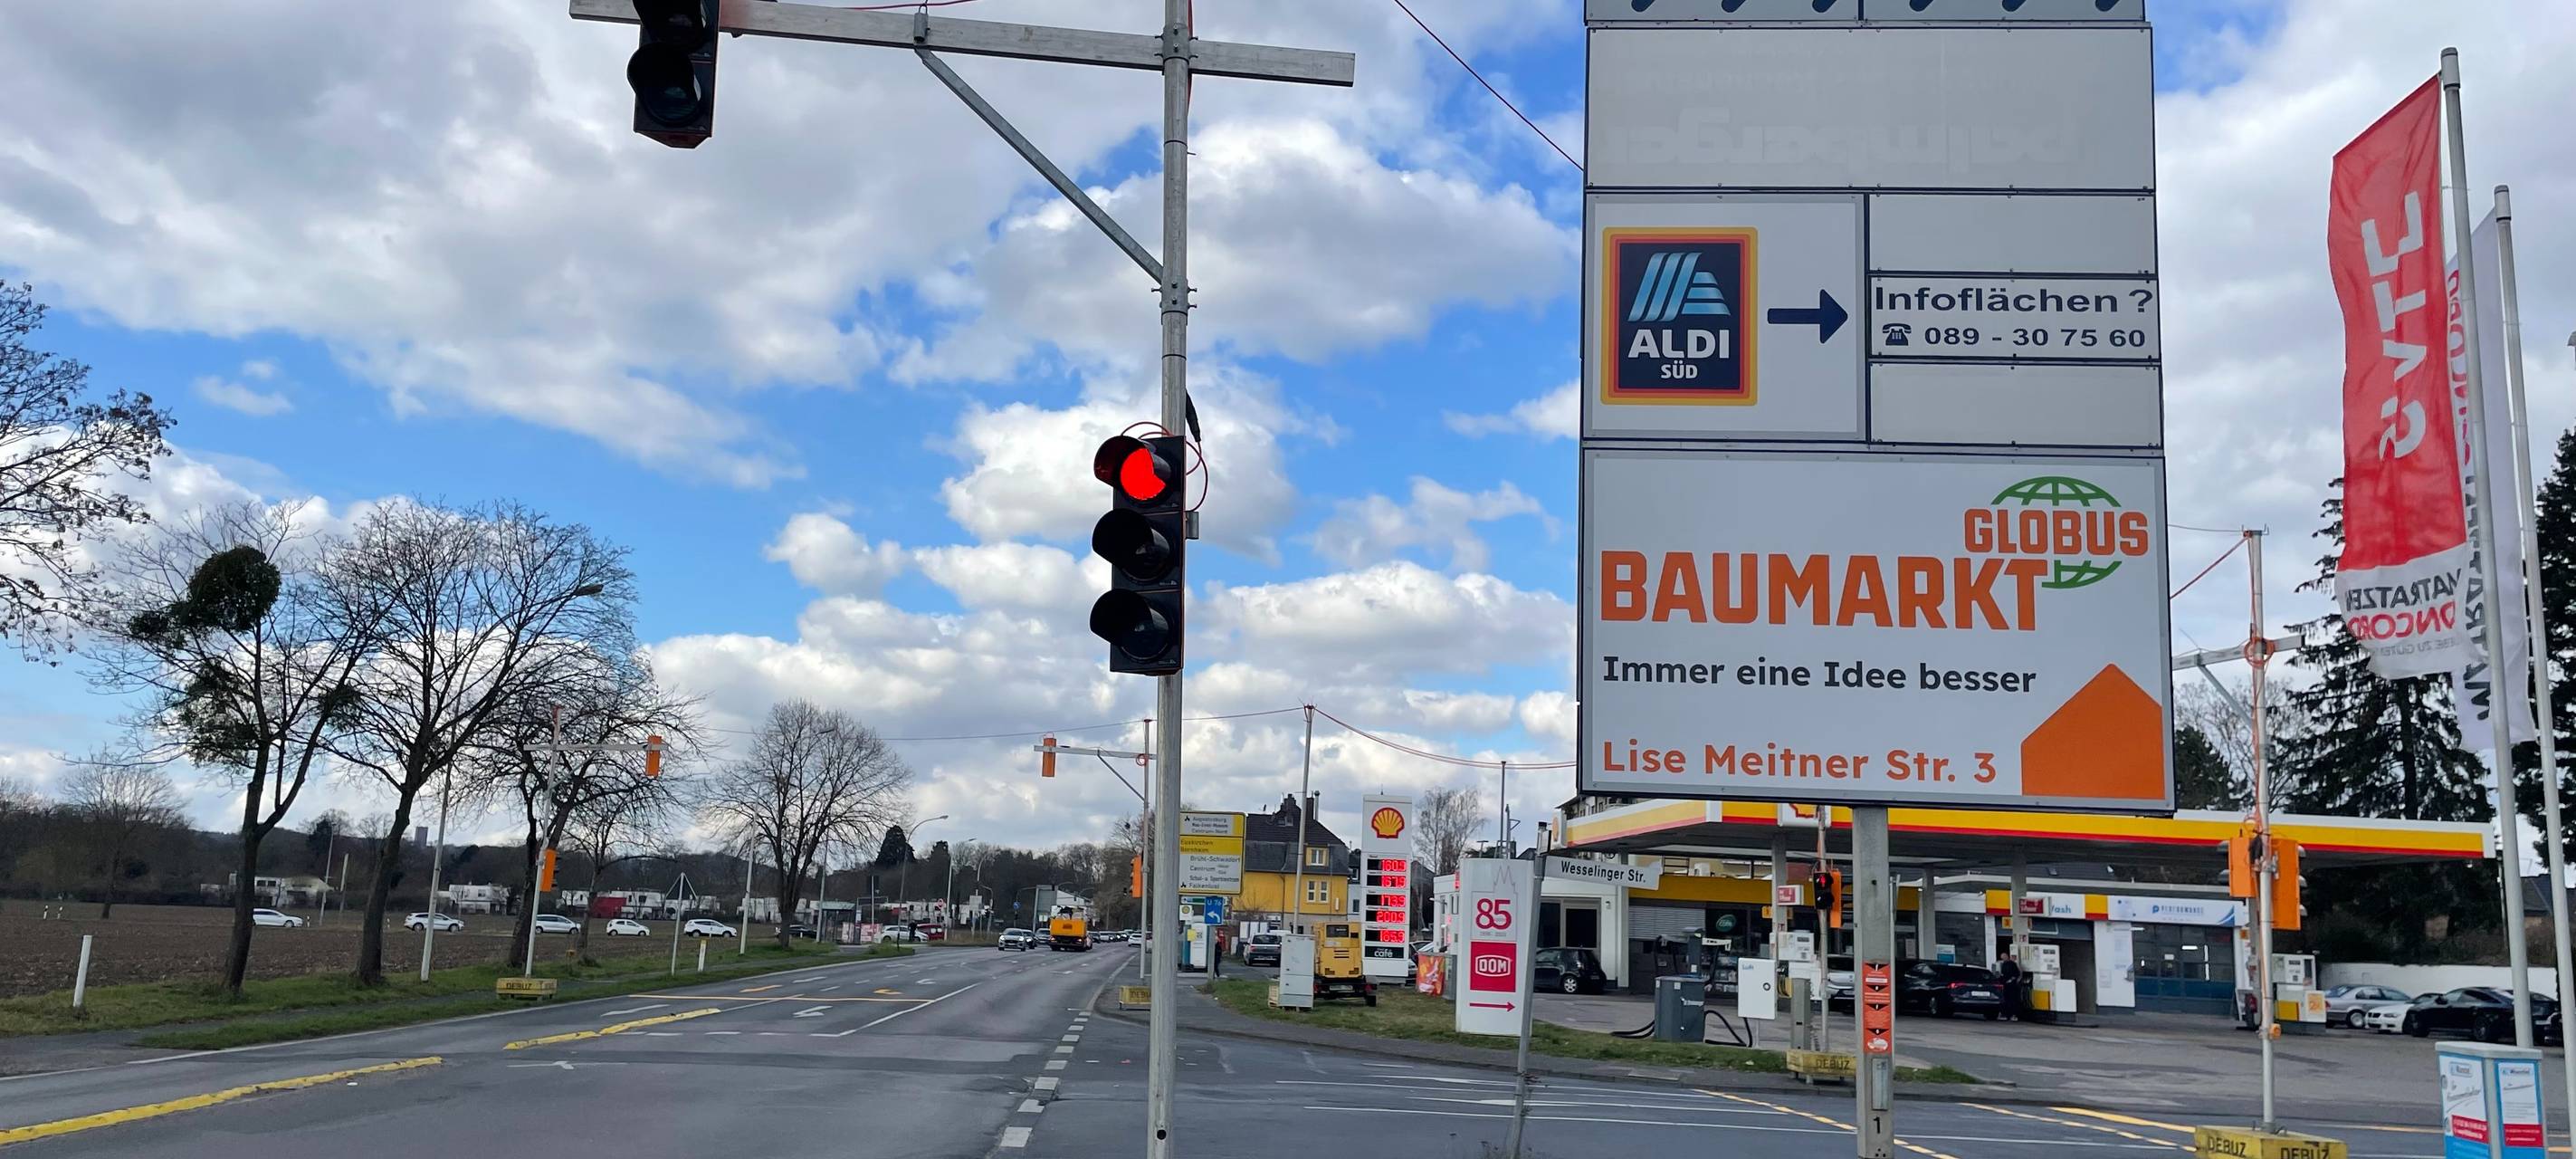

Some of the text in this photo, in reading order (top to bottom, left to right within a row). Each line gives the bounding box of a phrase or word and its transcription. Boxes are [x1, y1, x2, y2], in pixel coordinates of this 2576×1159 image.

[1875, 286, 2153, 313] Infoflächen ?
[1627, 328, 1730, 359] ALDI
[1924, 327, 1980, 346] 089
[2012, 328, 2048, 347] 30
[2060, 328, 2097, 347] 75
[2109, 329, 2145, 348] 60
[1661, 361, 1698, 379] SÜD
[1964, 508, 2148, 557] GLOBUS
[1600, 551, 2047, 631] BAUMARKT
[1603, 656, 2037, 693] Immer eine Idee besser
[1603, 739, 1996, 783] Lise Meitner Str. 3
[1561, 860, 1646, 883] Wesselinger Str.
[1476, 898, 1512, 930] 85
[1479, 958, 1507, 973] DOM
[1816, 1058, 1851, 1070] DEBUZ
[1873, 1116, 1881, 1135] 1
[2207, 1136, 2247, 1158] DEBUZ
